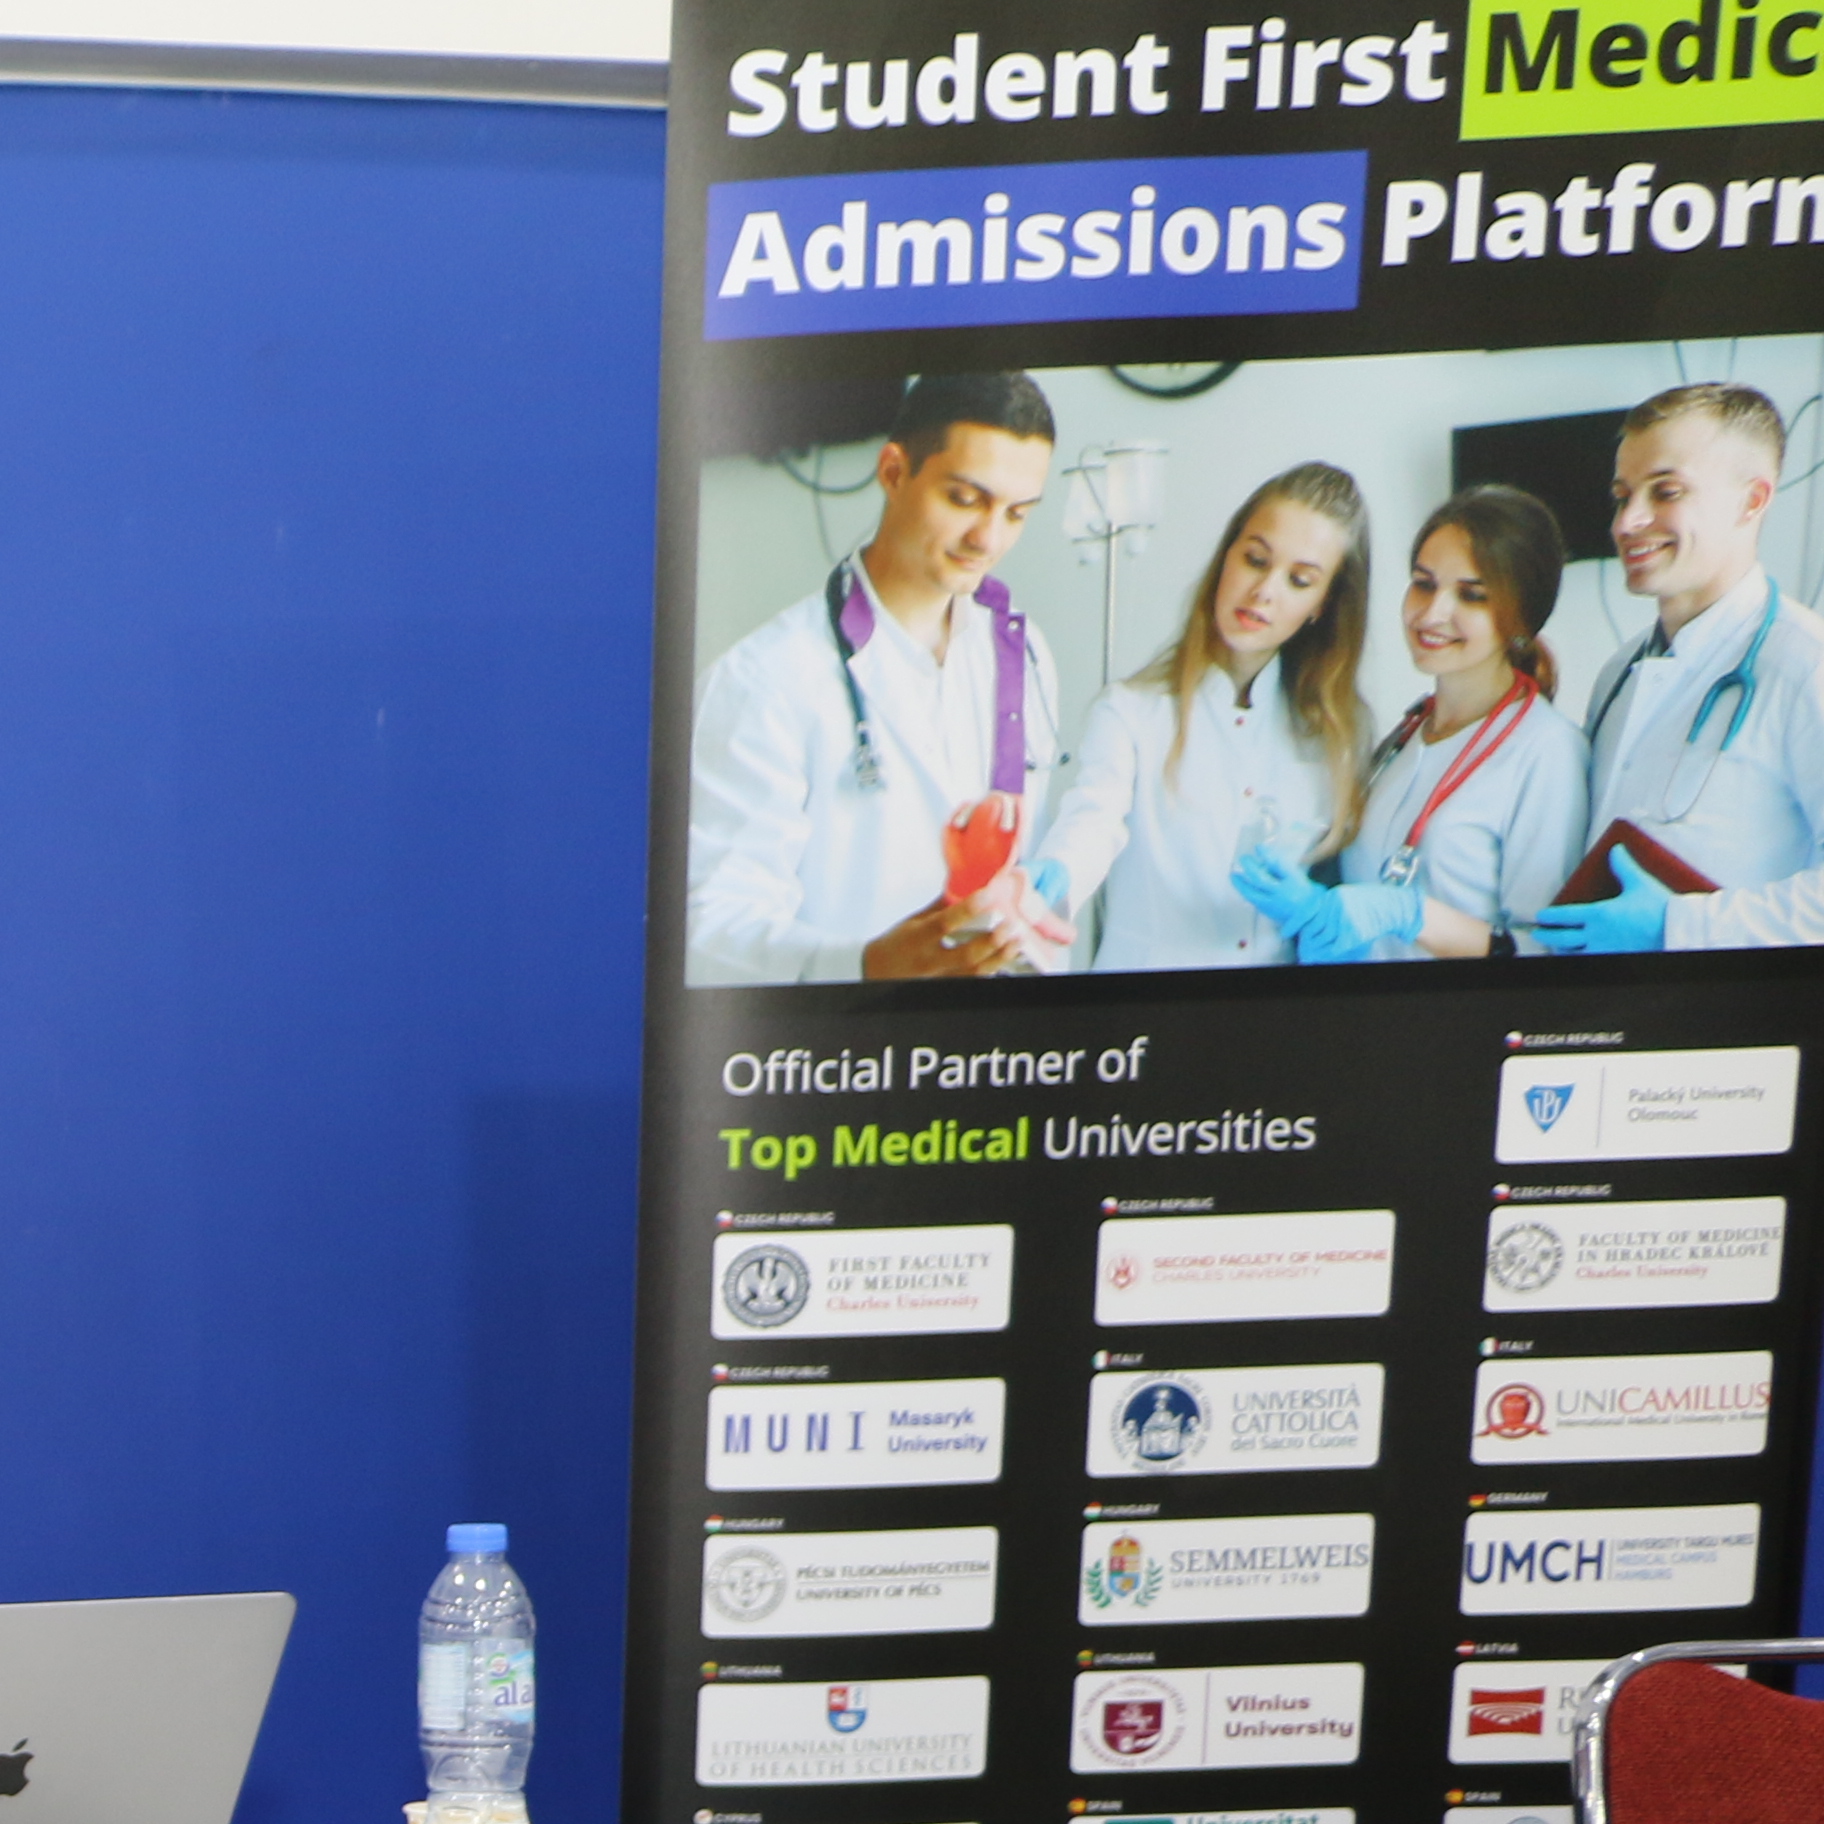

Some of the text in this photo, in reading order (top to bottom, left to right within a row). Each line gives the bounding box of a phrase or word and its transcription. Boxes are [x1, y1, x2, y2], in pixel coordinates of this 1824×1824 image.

[727, 0, 1824, 137] Student First Medic
[718, 187, 1347, 300] Admissions
[721, 1036, 1150, 1096] Official Partner of
[1689, 1084, 1766, 1102] University
[1626, 1106, 1699, 1123] Olomouc
[718, 1108, 1318, 1181] Top Medical Universities
[1578, 1225, 1782, 1247] FACULTY OF MEDICINE
[827, 1252, 992, 1273] FIRST FACULTY
[1153, 1248, 1389, 1269] SECOND FACULTY OF MEDICINE
[1577, 1245, 1683, 1263] IN HRADEC
[827, 1271, 970, 1291] OF MEDICINE
[898, 1292, 980, 1312] University
[1231, 1384, 1362, 1413] UNIVERSITÀ
[1556, 1382, 1773, 1416] UNICAMILLUS
[888, 1407, 975, 1428] Masaryk
[1231, 1410, 1360, 1435] CATTOLICA
[887, 1433, 989, 1455] University
[1230, 1433, 1359, 1451] del Sacro Cuore
[1169, 1543, 1371, 1574] SEMMELWEIS
[1464, 1539, 1606, 1585] UMCH
[1170, 1573, 1272, 1590] UNIVERSITY
[1226, 1694, 1310, 1713] Vilnius
[1224, 1718, 1355, 1740] University
[710, 1733, 974, 1758] LITHUANIAN UNIVERSITY
[708, 1753, 973, 1779] OF HEALTH SCIENCES
